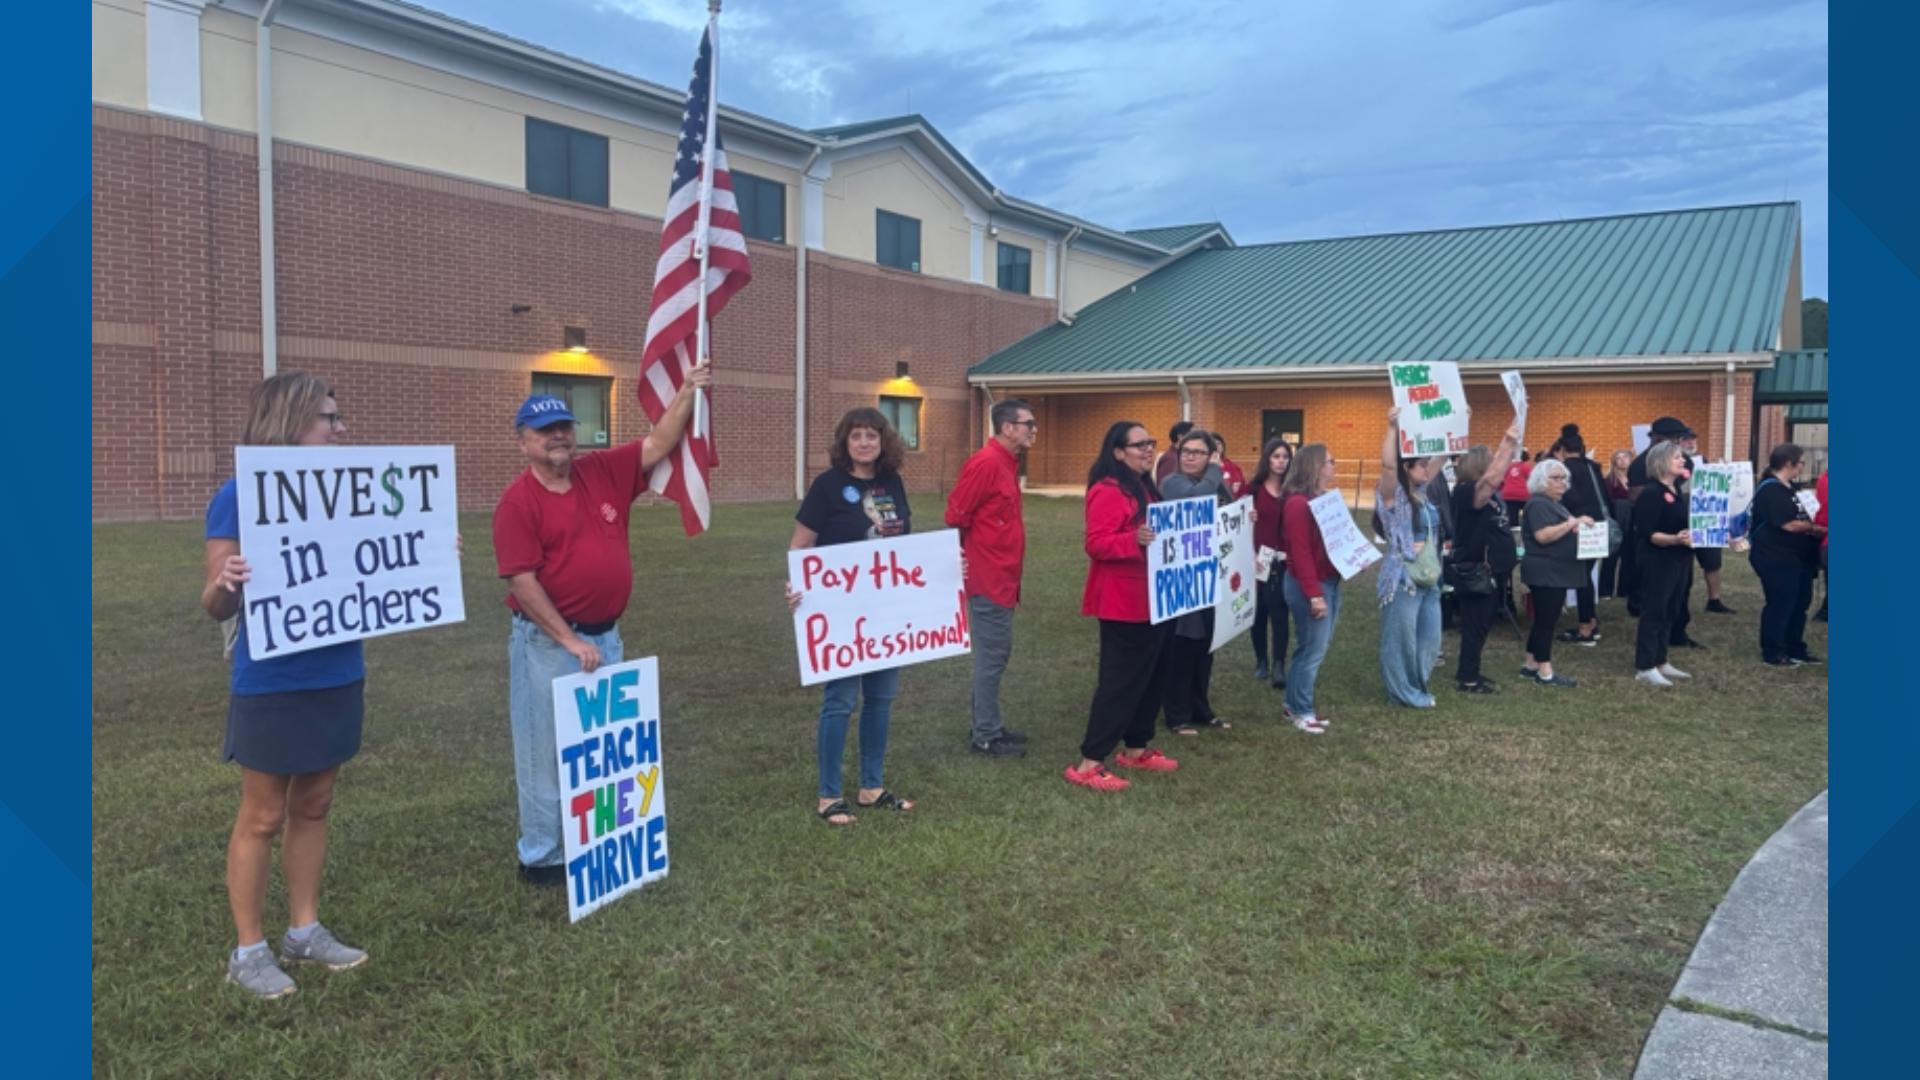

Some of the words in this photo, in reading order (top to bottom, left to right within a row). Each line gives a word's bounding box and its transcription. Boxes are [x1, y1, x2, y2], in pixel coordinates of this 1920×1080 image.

[280, 535, 328, 588] in
[355, 530, 424, 575] our
[803, 555, 859, 593] Pay
[869, 550, 926, 589] the
[1163, 537, 1176, 564] IS
[1181, 530, 1213, 560] THE
[250, 581, 442, 652] Teachers
[1156, 556, 1218, 619] PRIORITY
[574, 669, 639, 733] WE
[562, 719, 658, 790] TEACH
[571, 764, 659, 845] THEY
[568, 815, 666, 908] THRIVE
